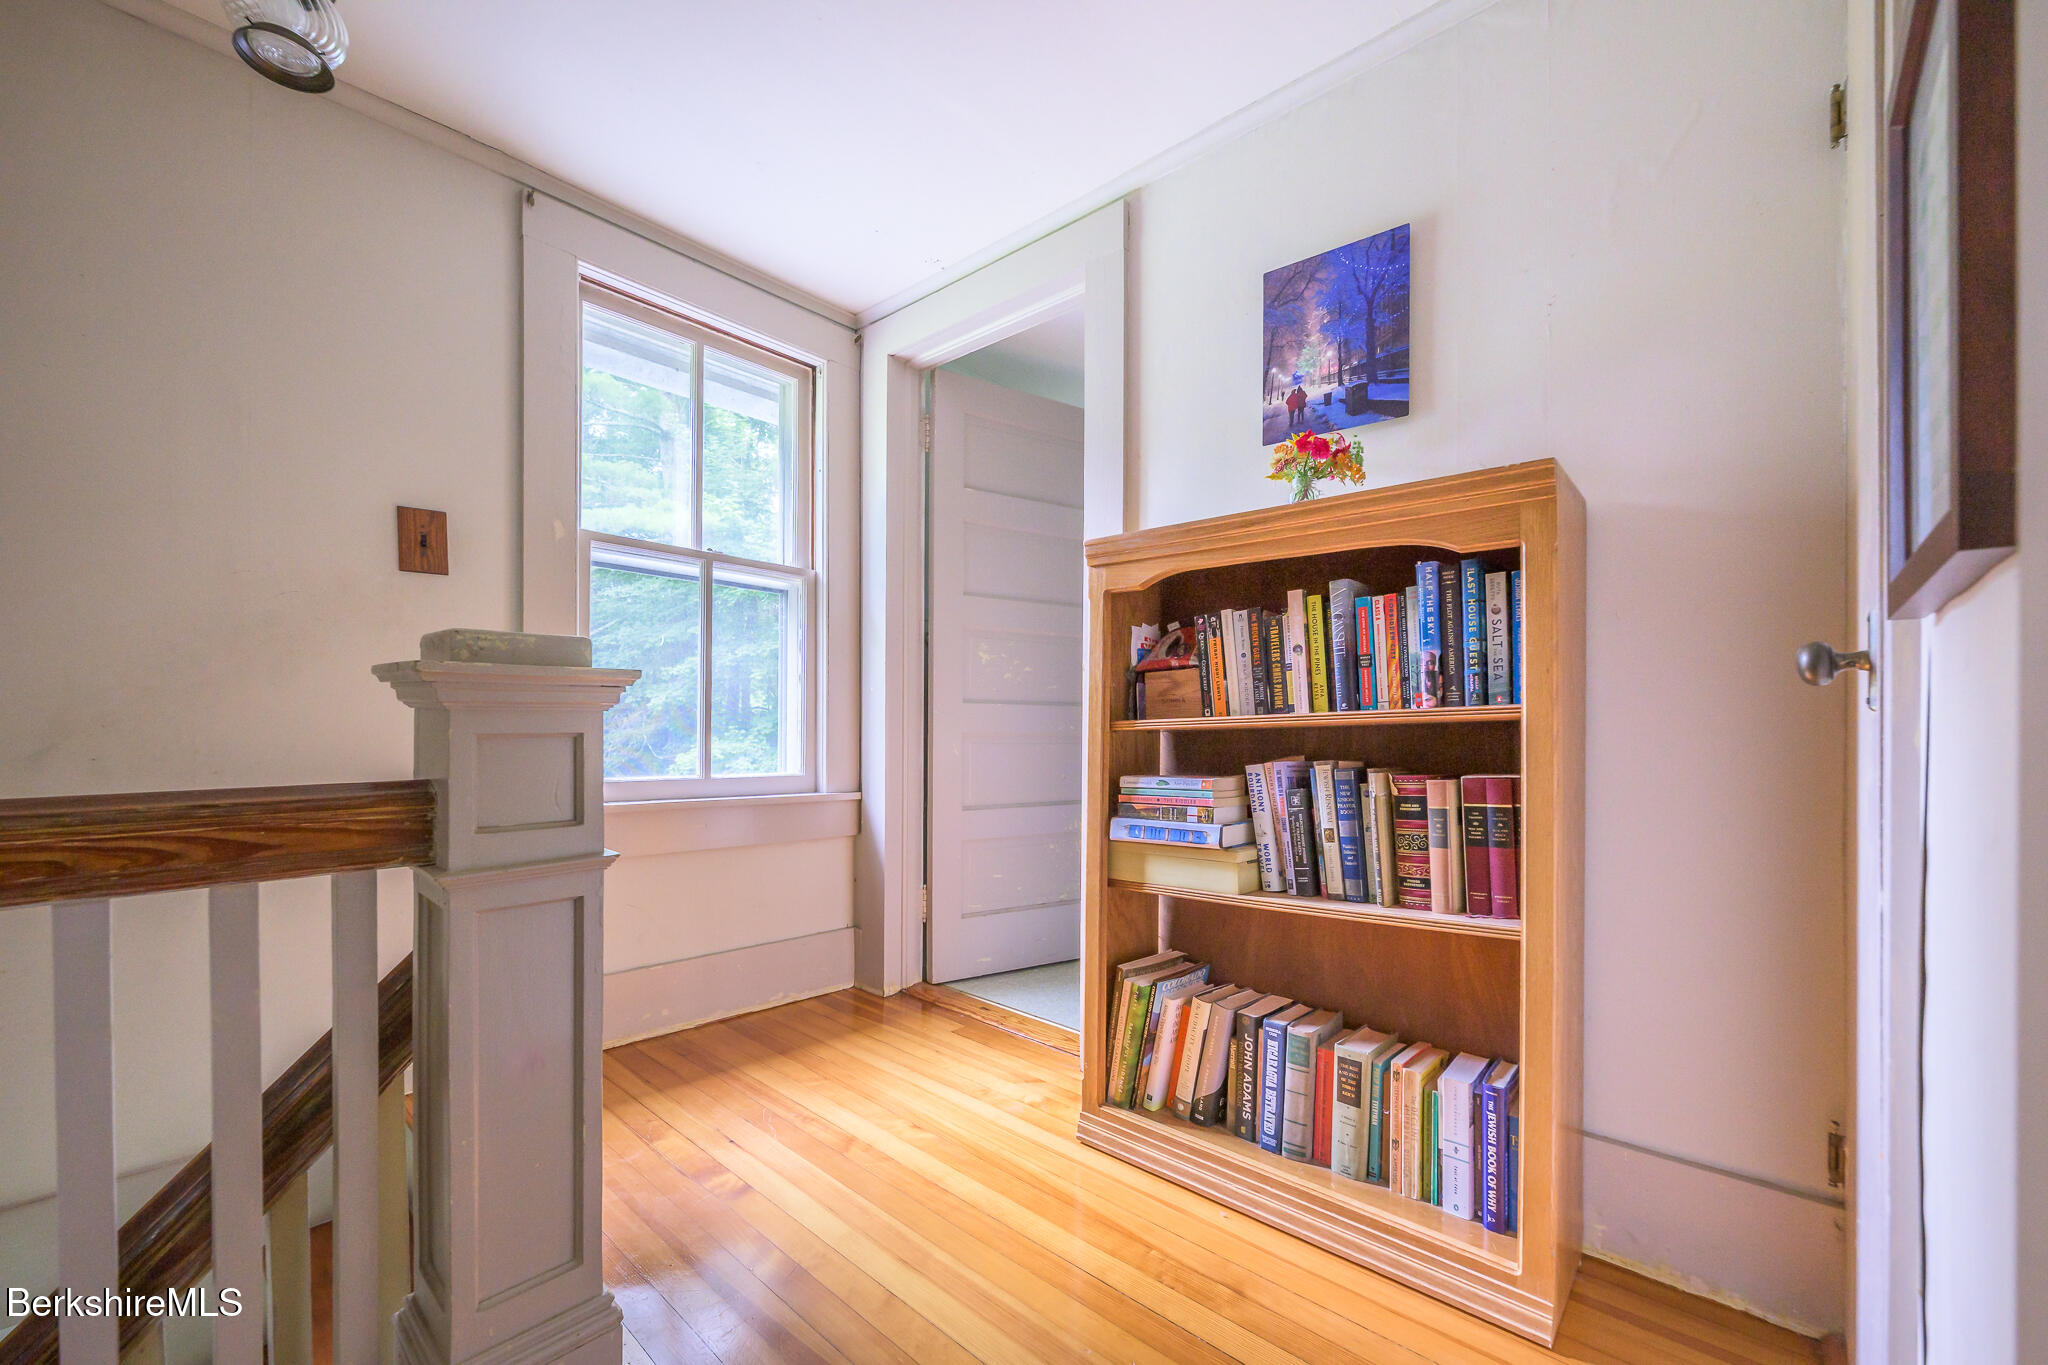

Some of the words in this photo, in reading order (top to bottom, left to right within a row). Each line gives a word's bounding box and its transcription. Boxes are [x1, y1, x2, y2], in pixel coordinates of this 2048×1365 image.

[1425, 567, 1433, 591] HALF
[1467, 571, 1475, 593] LAST
[1388, 598, 1396, 640] FORBIDDEN
[1468, 599, 1476, 632] HOUSE
[1270, 626, 1280, 661] TRAVELERS
[1492, 619, 1502, 648] SALT
[1252, 648, 1260, 665] GIRLS
[1469, 638, 1478, 671] GUEST
[1493, 658, 1503, 681] SEA
[1272, 664, 1281, 683] CHRIS
[1247, 773, 1257, 813] BOURDAIN
[1255, 773, 1265, 812] ANTHONY
[1322, 769, 1331, 792] JEWISH
[1325, 793, 1333, 823] RENEWAL
[1263, 843, 1272, 873] WORLD
[1162, 969, 1206, 991] COLORADO
[1147, 985, 1156, 1012] COLORADO
[1190, 1013, 1199, 1045] AUDACITY
[1184, 1054, 1192, 1073] HOPE
[1244, 1033, 1253, 1070] JOHN
[1265, 1039, 1278, 1087] NICARAGUA
[1118, 1061, 1128, 1094] EVIDENCE
[1242, 1073, 1252, 1120] ADAMS
[1264, 1088, 1276, 1135] BETRAYED
[1486, 1111, 1497, 1145] JEWISH
[1488, 1146, 1497, 1174] BOOK
[1488, 1175, 1497, 1189] OF
[1488, 1189, 1497, 1213] WHY
